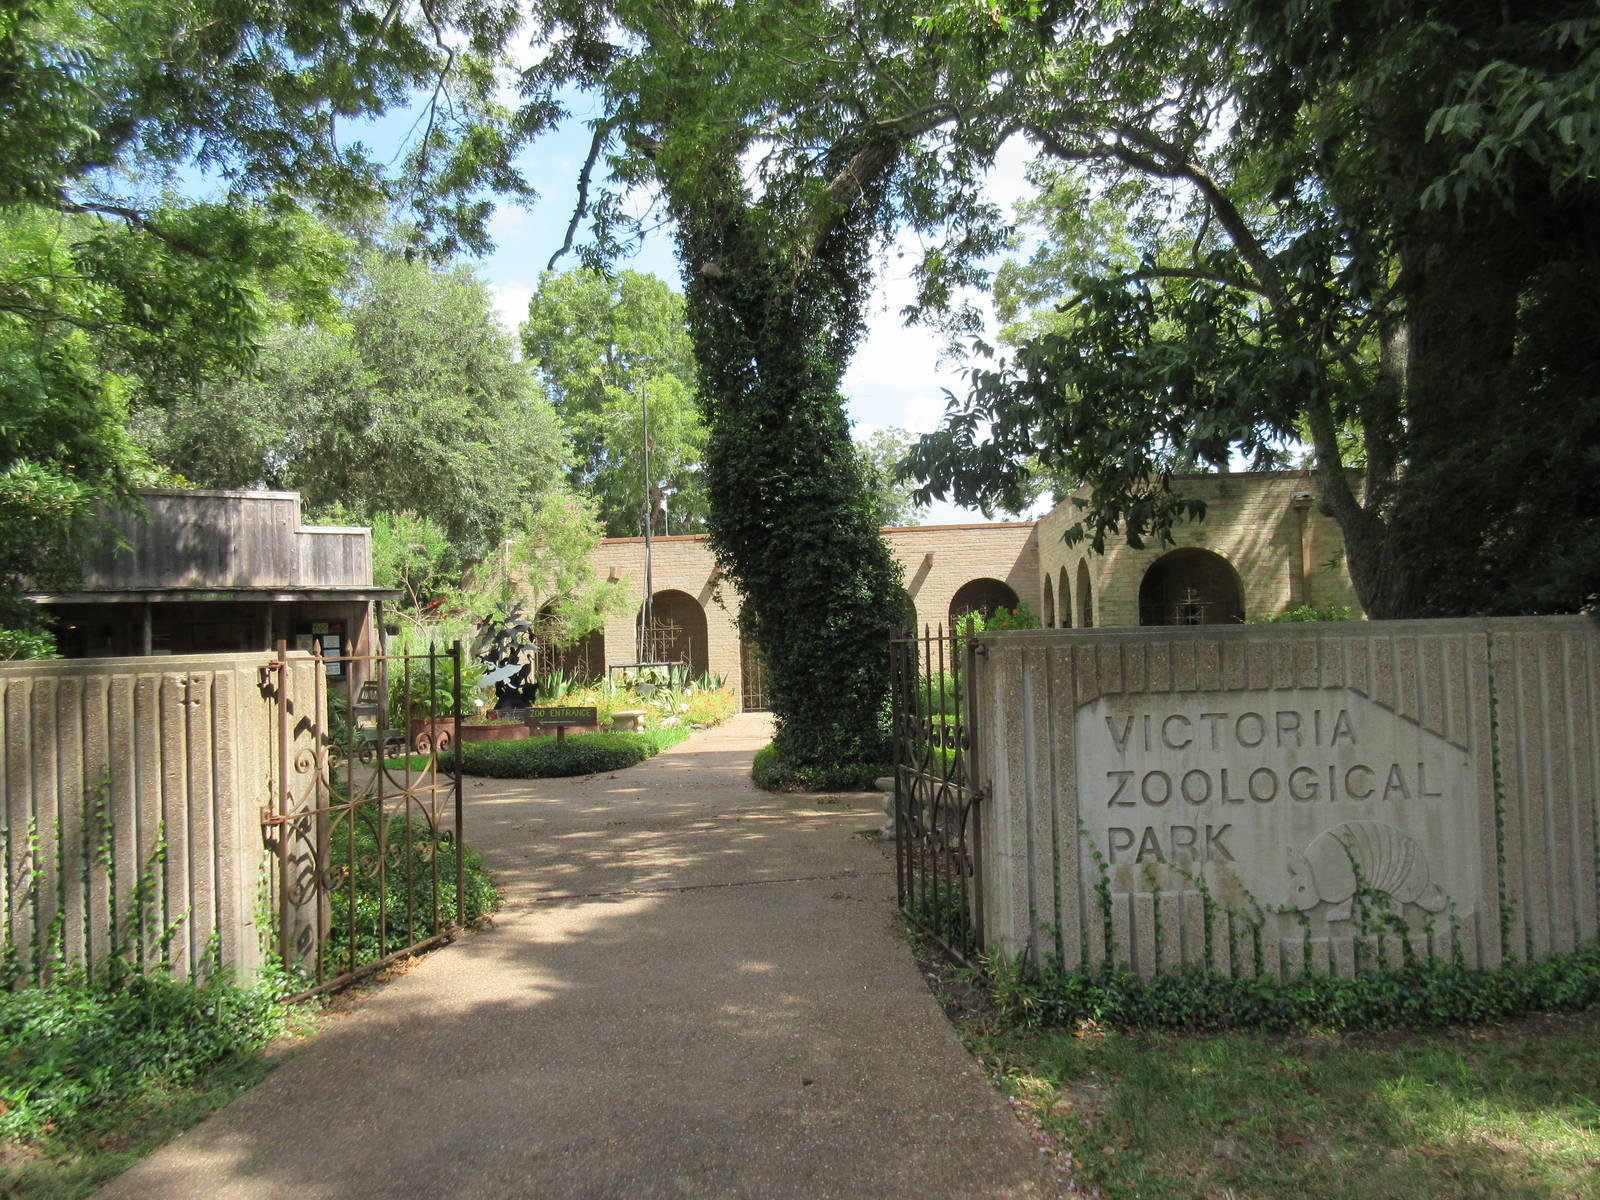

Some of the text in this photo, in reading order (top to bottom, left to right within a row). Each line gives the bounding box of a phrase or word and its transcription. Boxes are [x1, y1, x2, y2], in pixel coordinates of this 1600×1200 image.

[529, 709, 591, 718] ZOO ENTRANCE
[1105, 709, 1358, 753] VICTORIA
[1106, 762, 1442, 808] ZOOLOGICAL
[1107, 824, 1236, 865] PARK
